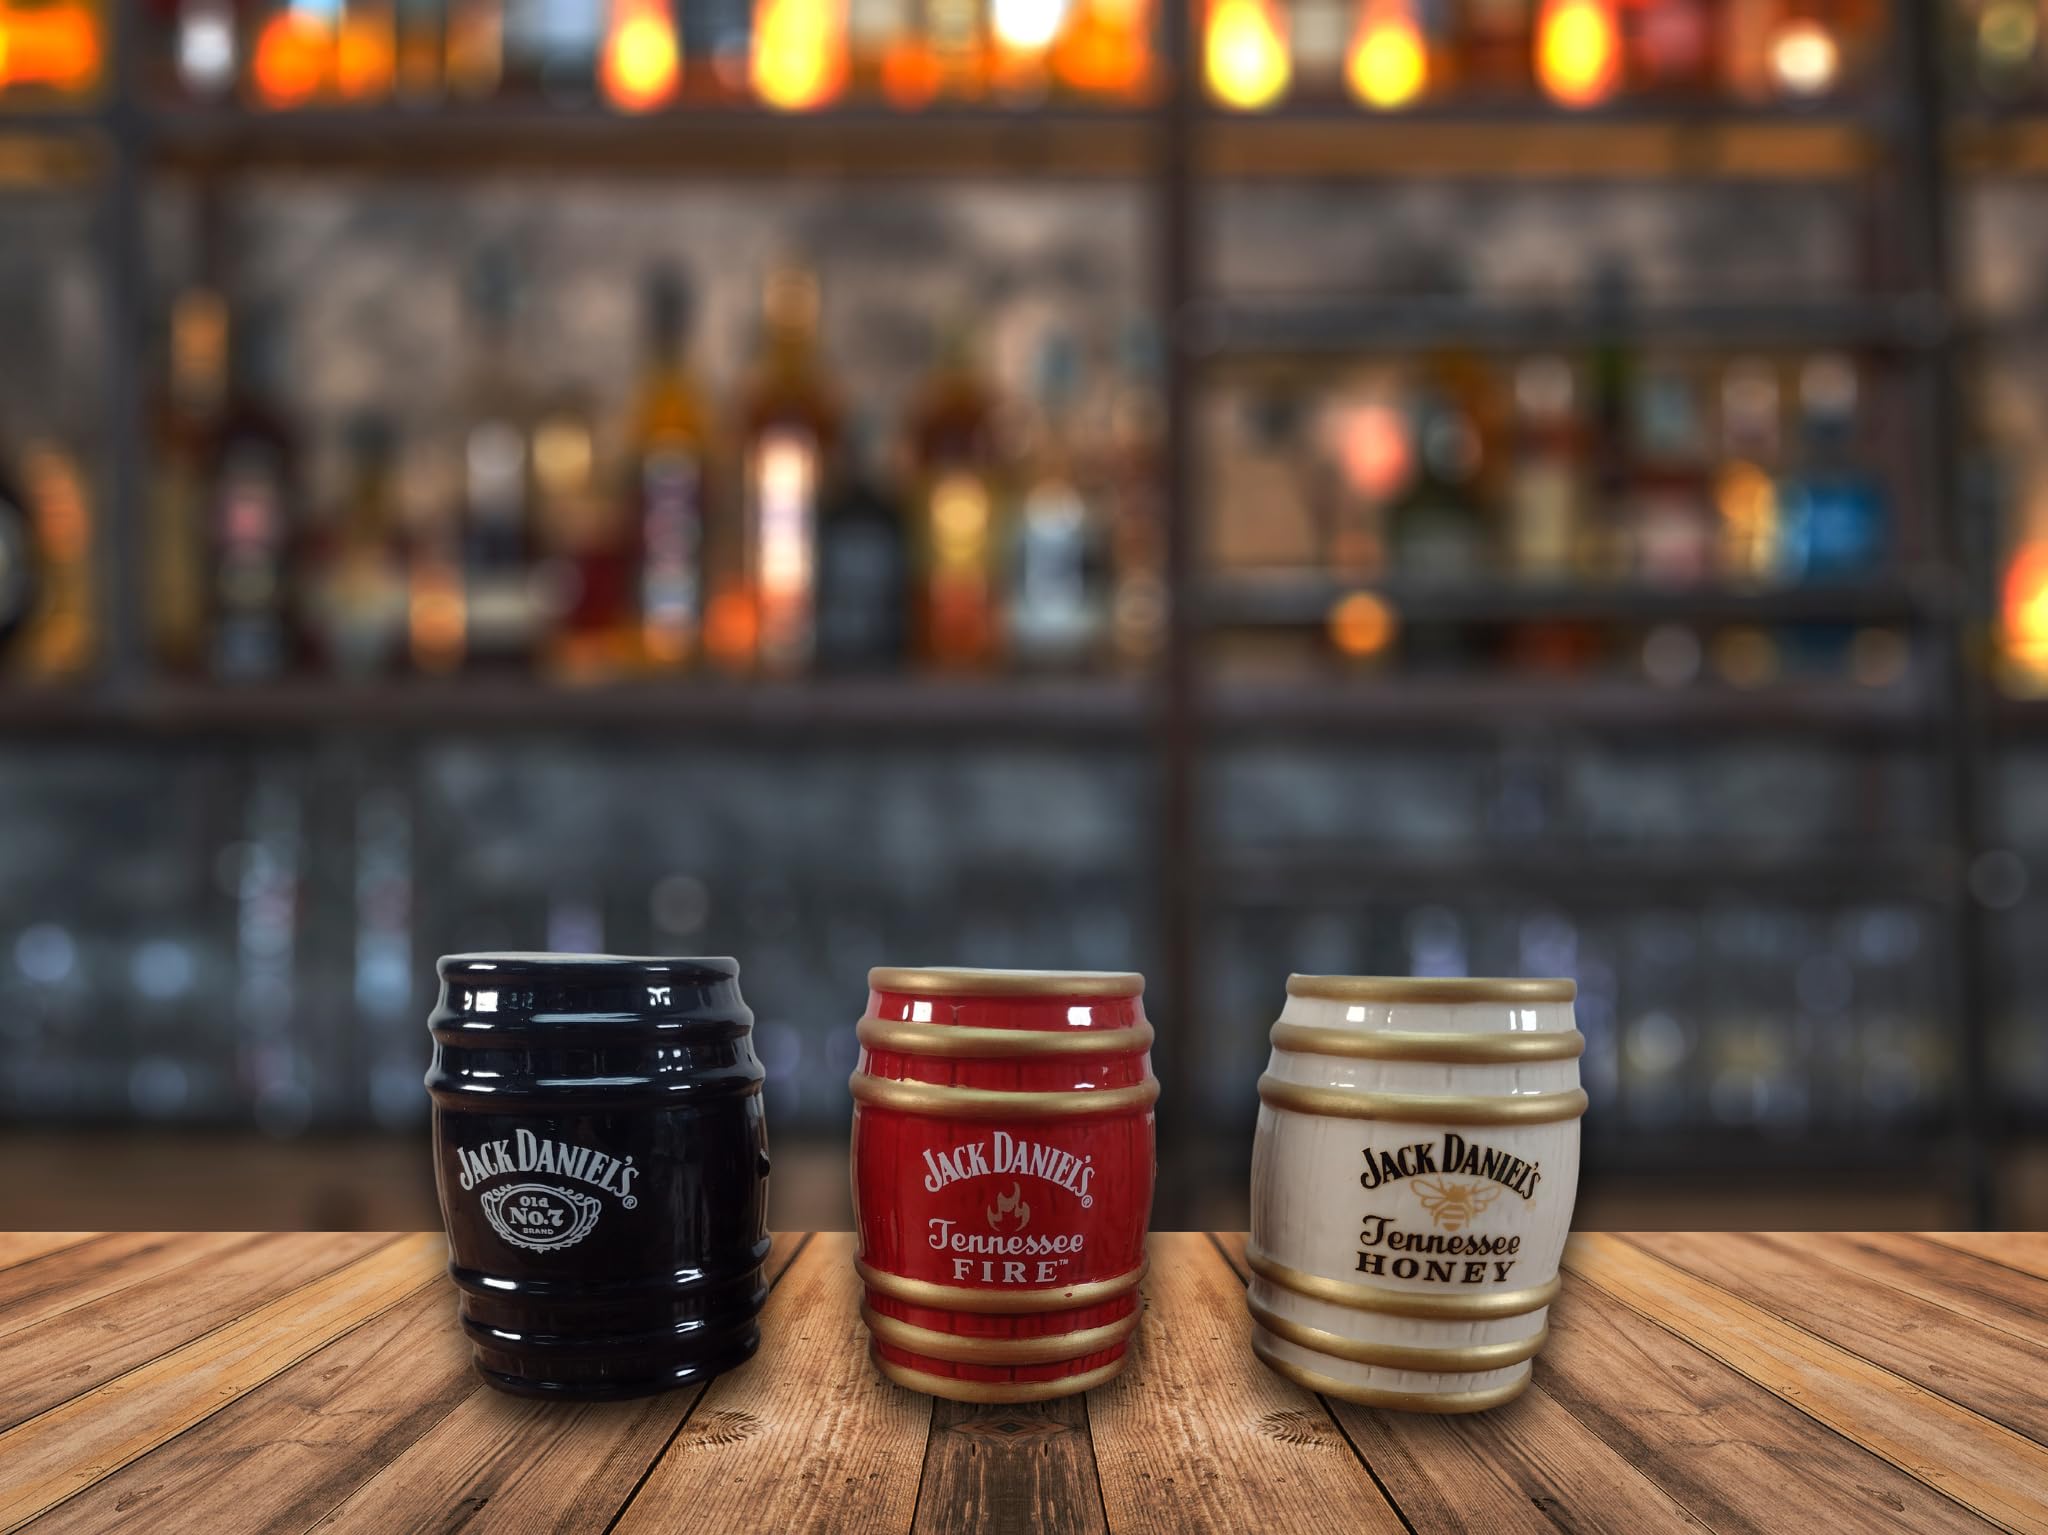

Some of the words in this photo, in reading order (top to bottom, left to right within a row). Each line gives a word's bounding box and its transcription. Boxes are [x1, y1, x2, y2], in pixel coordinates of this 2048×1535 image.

[457, 1139, 518, 1191] JACK
[515, 1128, 640, 1198] DANIEL'S
[922, 1142, 991, 1192] JACK
[993, 1131, 1095, 1197] DANIEL'S
[1360, 1142, 1436, 1190] JACK
[1442, 1133, 1541, 1200] DANIEL'S
[523, 1227, 555, 1235] BRAND
[928, 1218, 1084, 1255] Tennessee
[1359, 1214, 1521, 1256] Tennessee
[1355, 1251, 1516, 1284] HONEY
